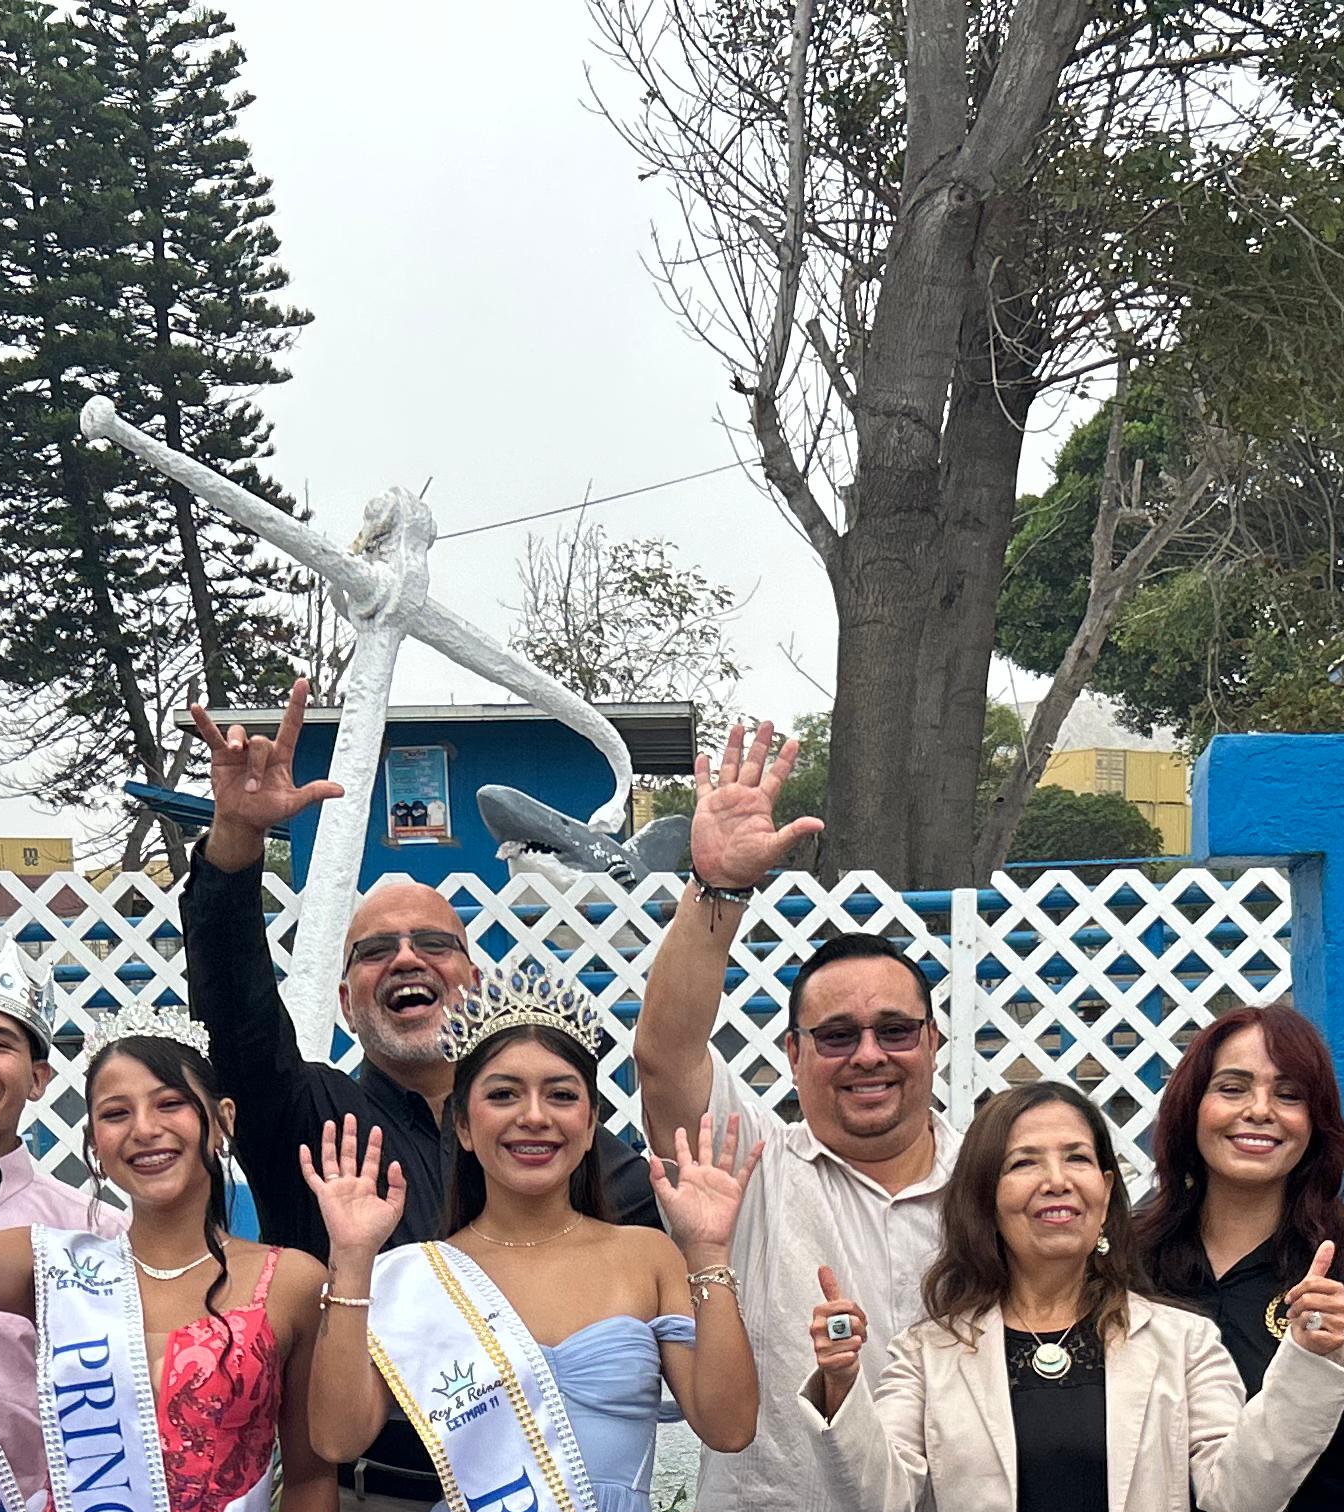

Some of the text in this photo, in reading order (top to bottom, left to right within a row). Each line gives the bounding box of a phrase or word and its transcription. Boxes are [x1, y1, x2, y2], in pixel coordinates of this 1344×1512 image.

[429, 1379, 505, 1425] Rey & Reina
[446, 1395, 500, 1431] CETMAR 11
